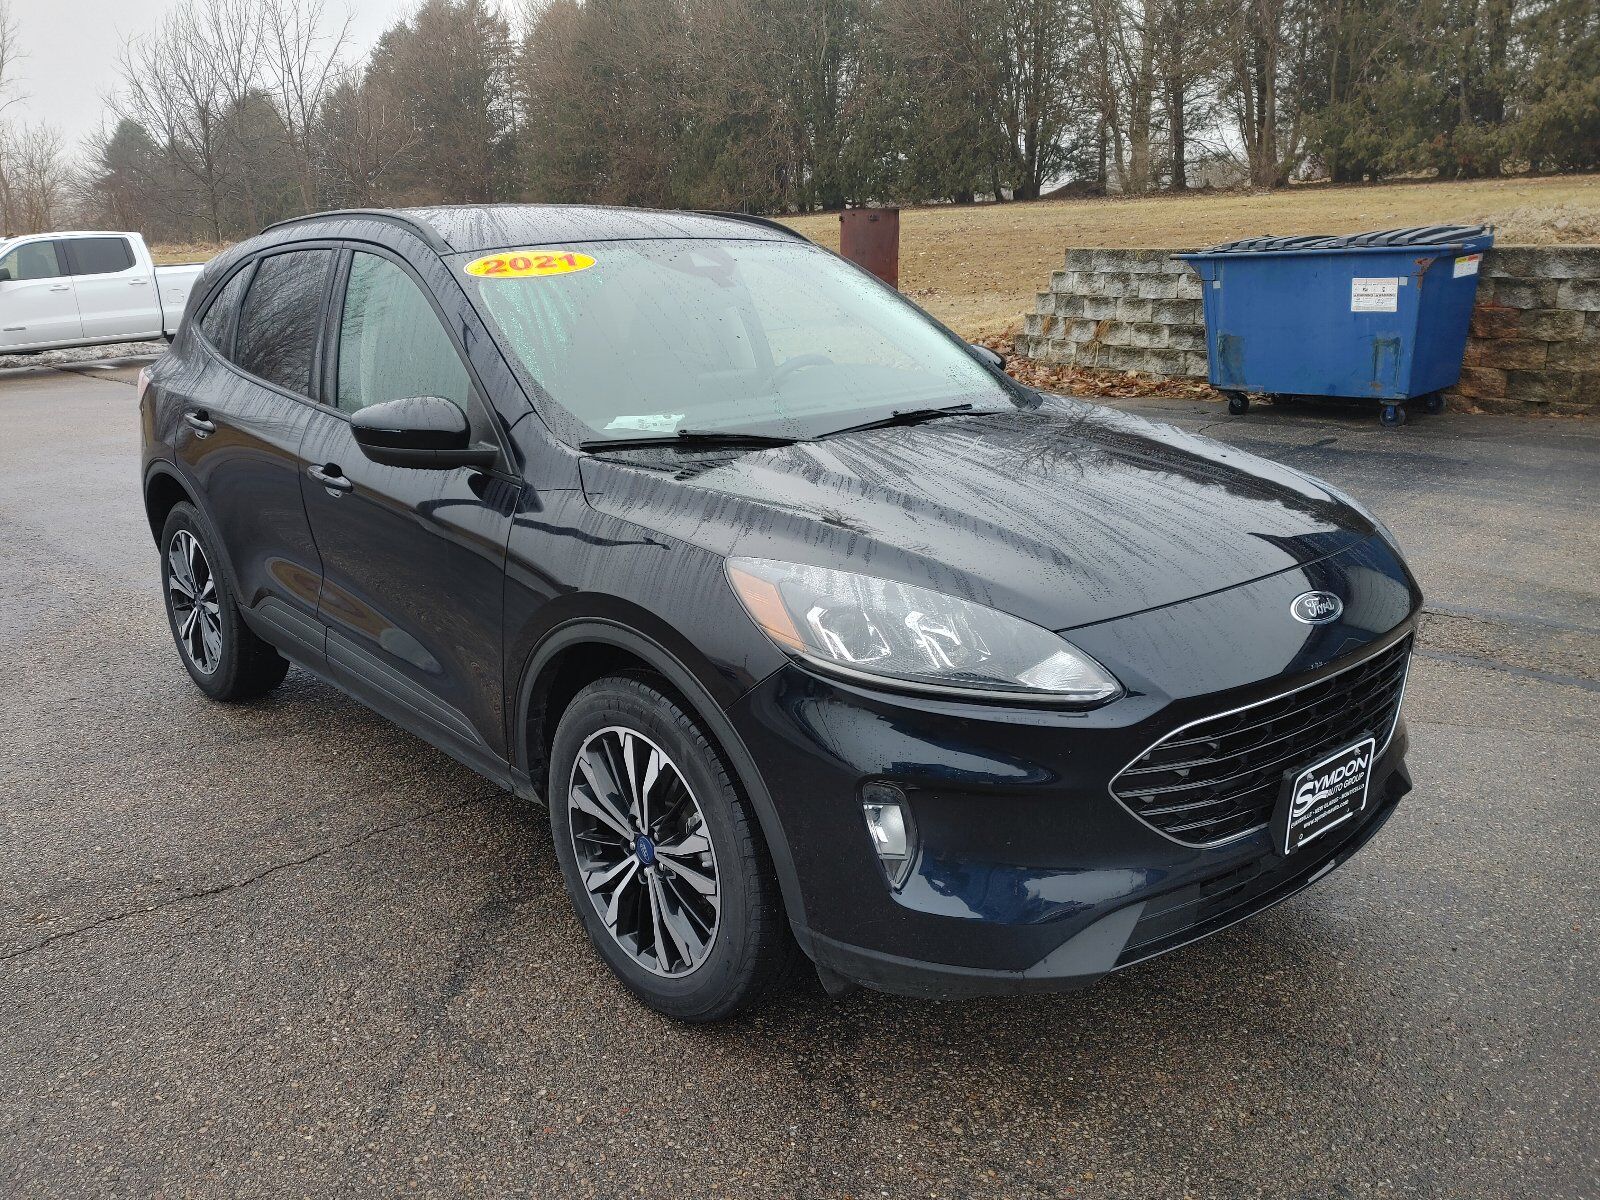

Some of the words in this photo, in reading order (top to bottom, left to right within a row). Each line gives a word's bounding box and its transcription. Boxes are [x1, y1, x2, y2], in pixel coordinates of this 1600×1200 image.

[483, 253, 577, 275] 2021
[1304, 596, 1335, 618] Ford
[1294, 754, 1370, 814] SYMDON
[1327, 782, 1344, 798] AUTO
[1343, 771, 1365, 788] GROUP
